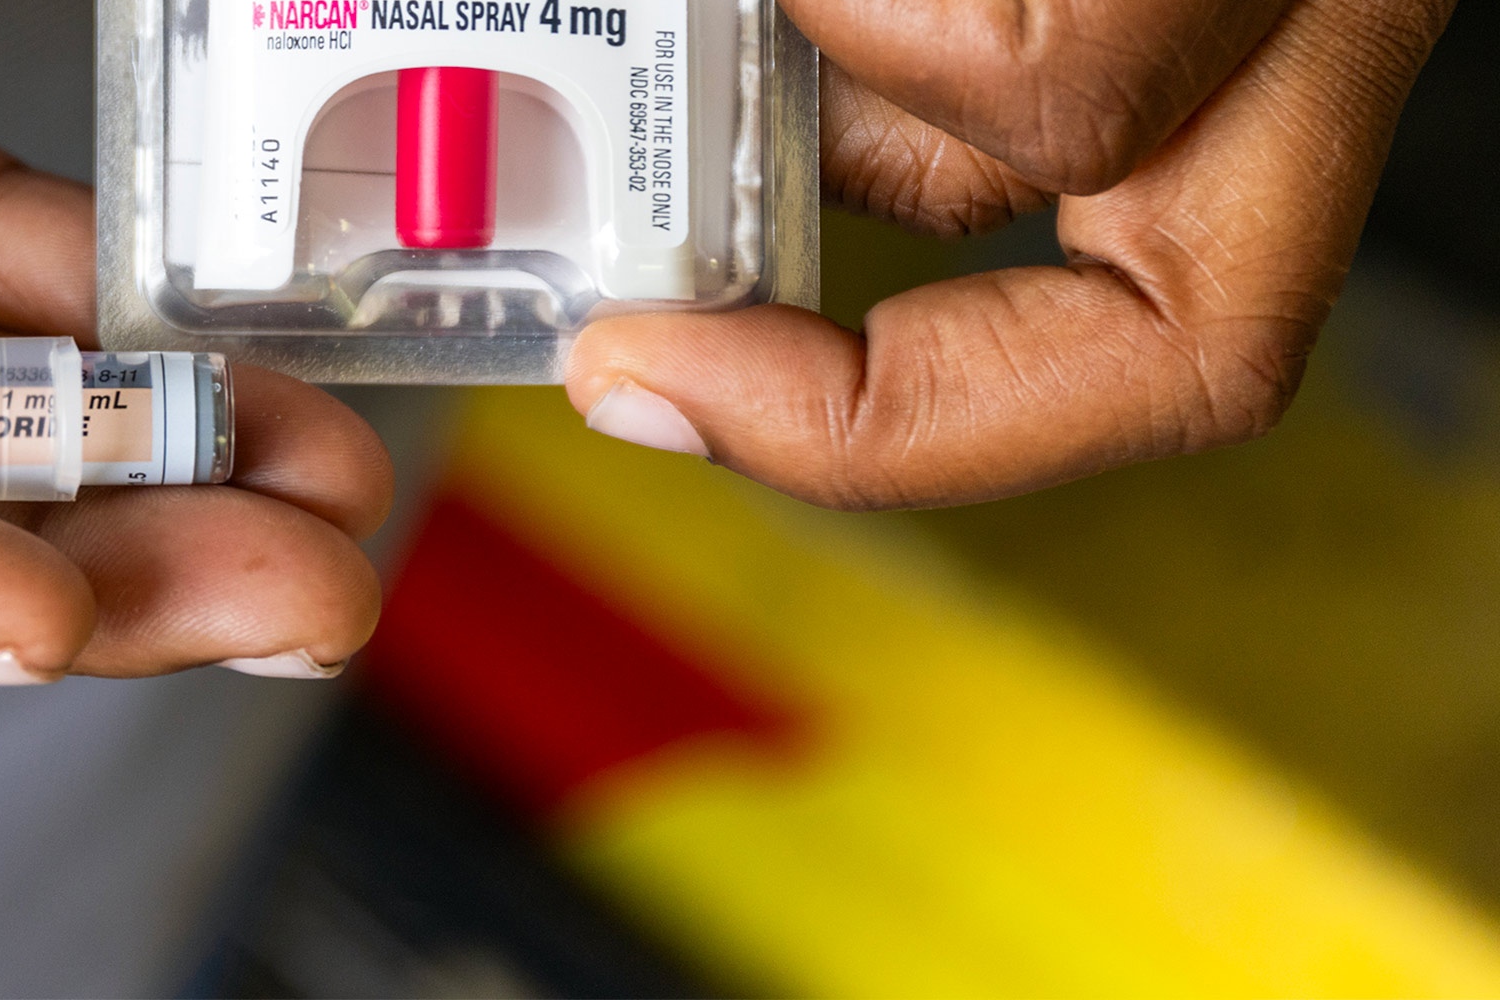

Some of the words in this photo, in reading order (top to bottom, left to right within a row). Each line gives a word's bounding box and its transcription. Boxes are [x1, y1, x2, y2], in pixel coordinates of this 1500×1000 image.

[371, 0, 450, 31] NASAL
[455, 0, 531, 33] SPRAY
[569, 5, 627, 47] mg
[266, 31, 326, 50] naloxone
[654, 30, 675, 59] FOR
[629, 66, 649, 99] NDC
[654, 63, 675, 92] USE
[653, 96, 674, 112] IN
[653, 116, 673, 144] THE
[628, 102, 648, 193] 69547-353-02
[260, 138, 280, 224] A1140
[652, 148, 673, 189] NOSE
[651, 193, 672, 231] ONLY
[98, 369, 138, 383] 8-11
[2, 389, 14, 410] 1
